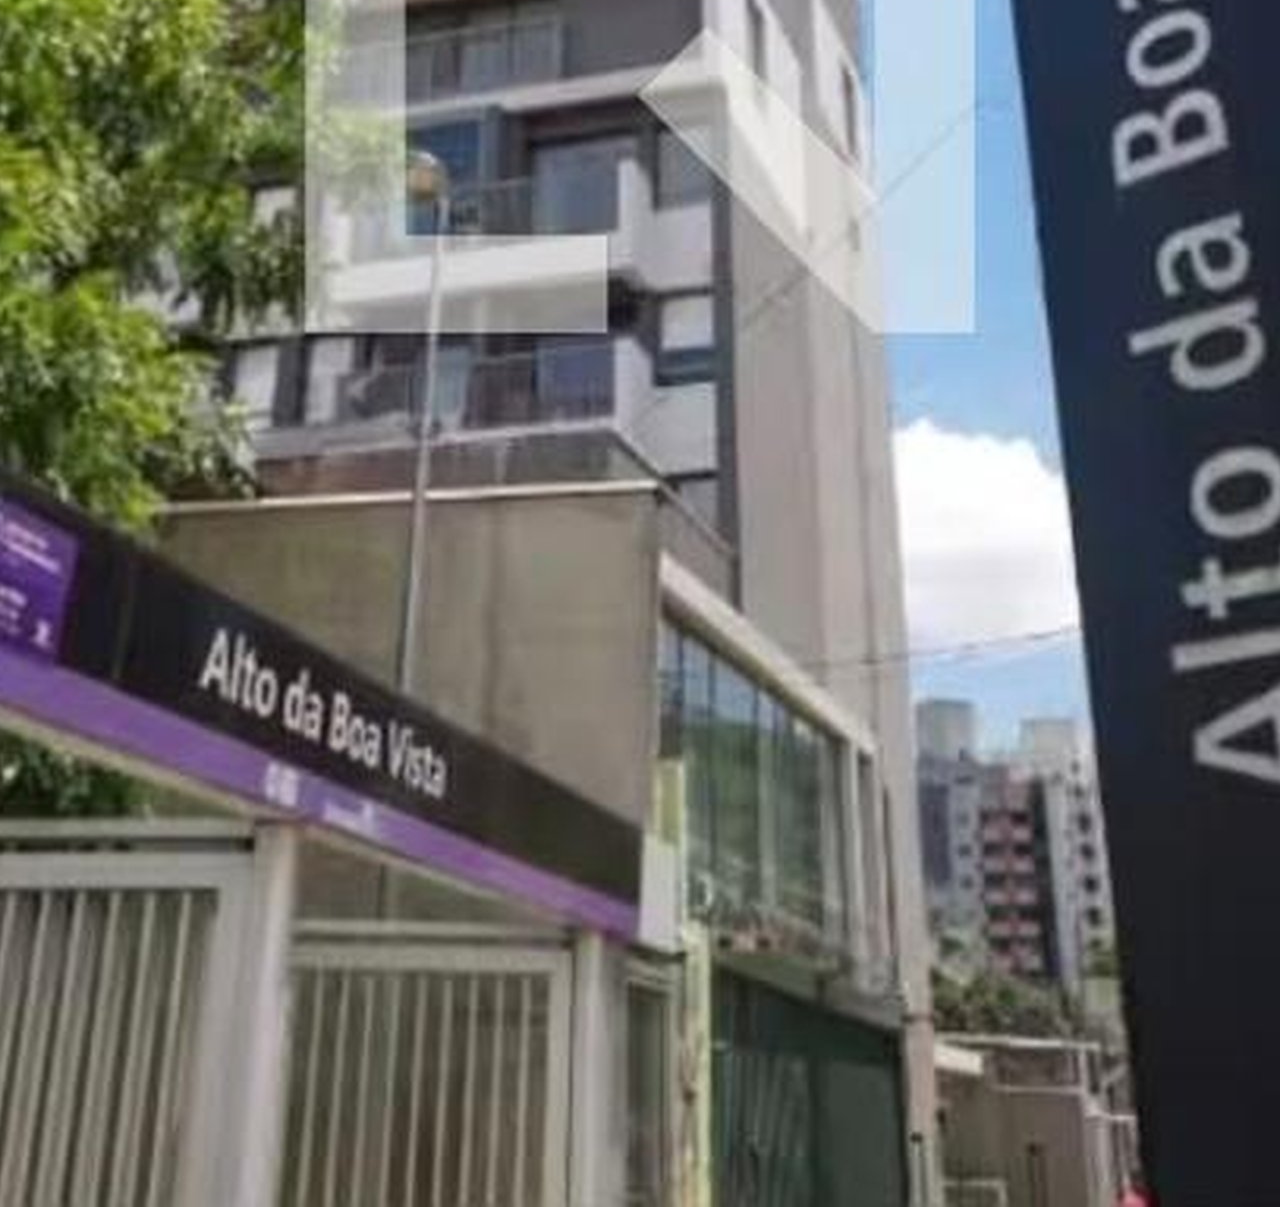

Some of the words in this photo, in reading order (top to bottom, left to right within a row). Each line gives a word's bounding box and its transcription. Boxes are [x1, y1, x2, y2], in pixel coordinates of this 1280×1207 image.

[1128, 210, 1267, 392] da
[198, 627, 279, 718] Alto
[282, 668, 325, 742] da
[327, 692, 383, 769] Boa
[388, 720, 448, 800] Vista
